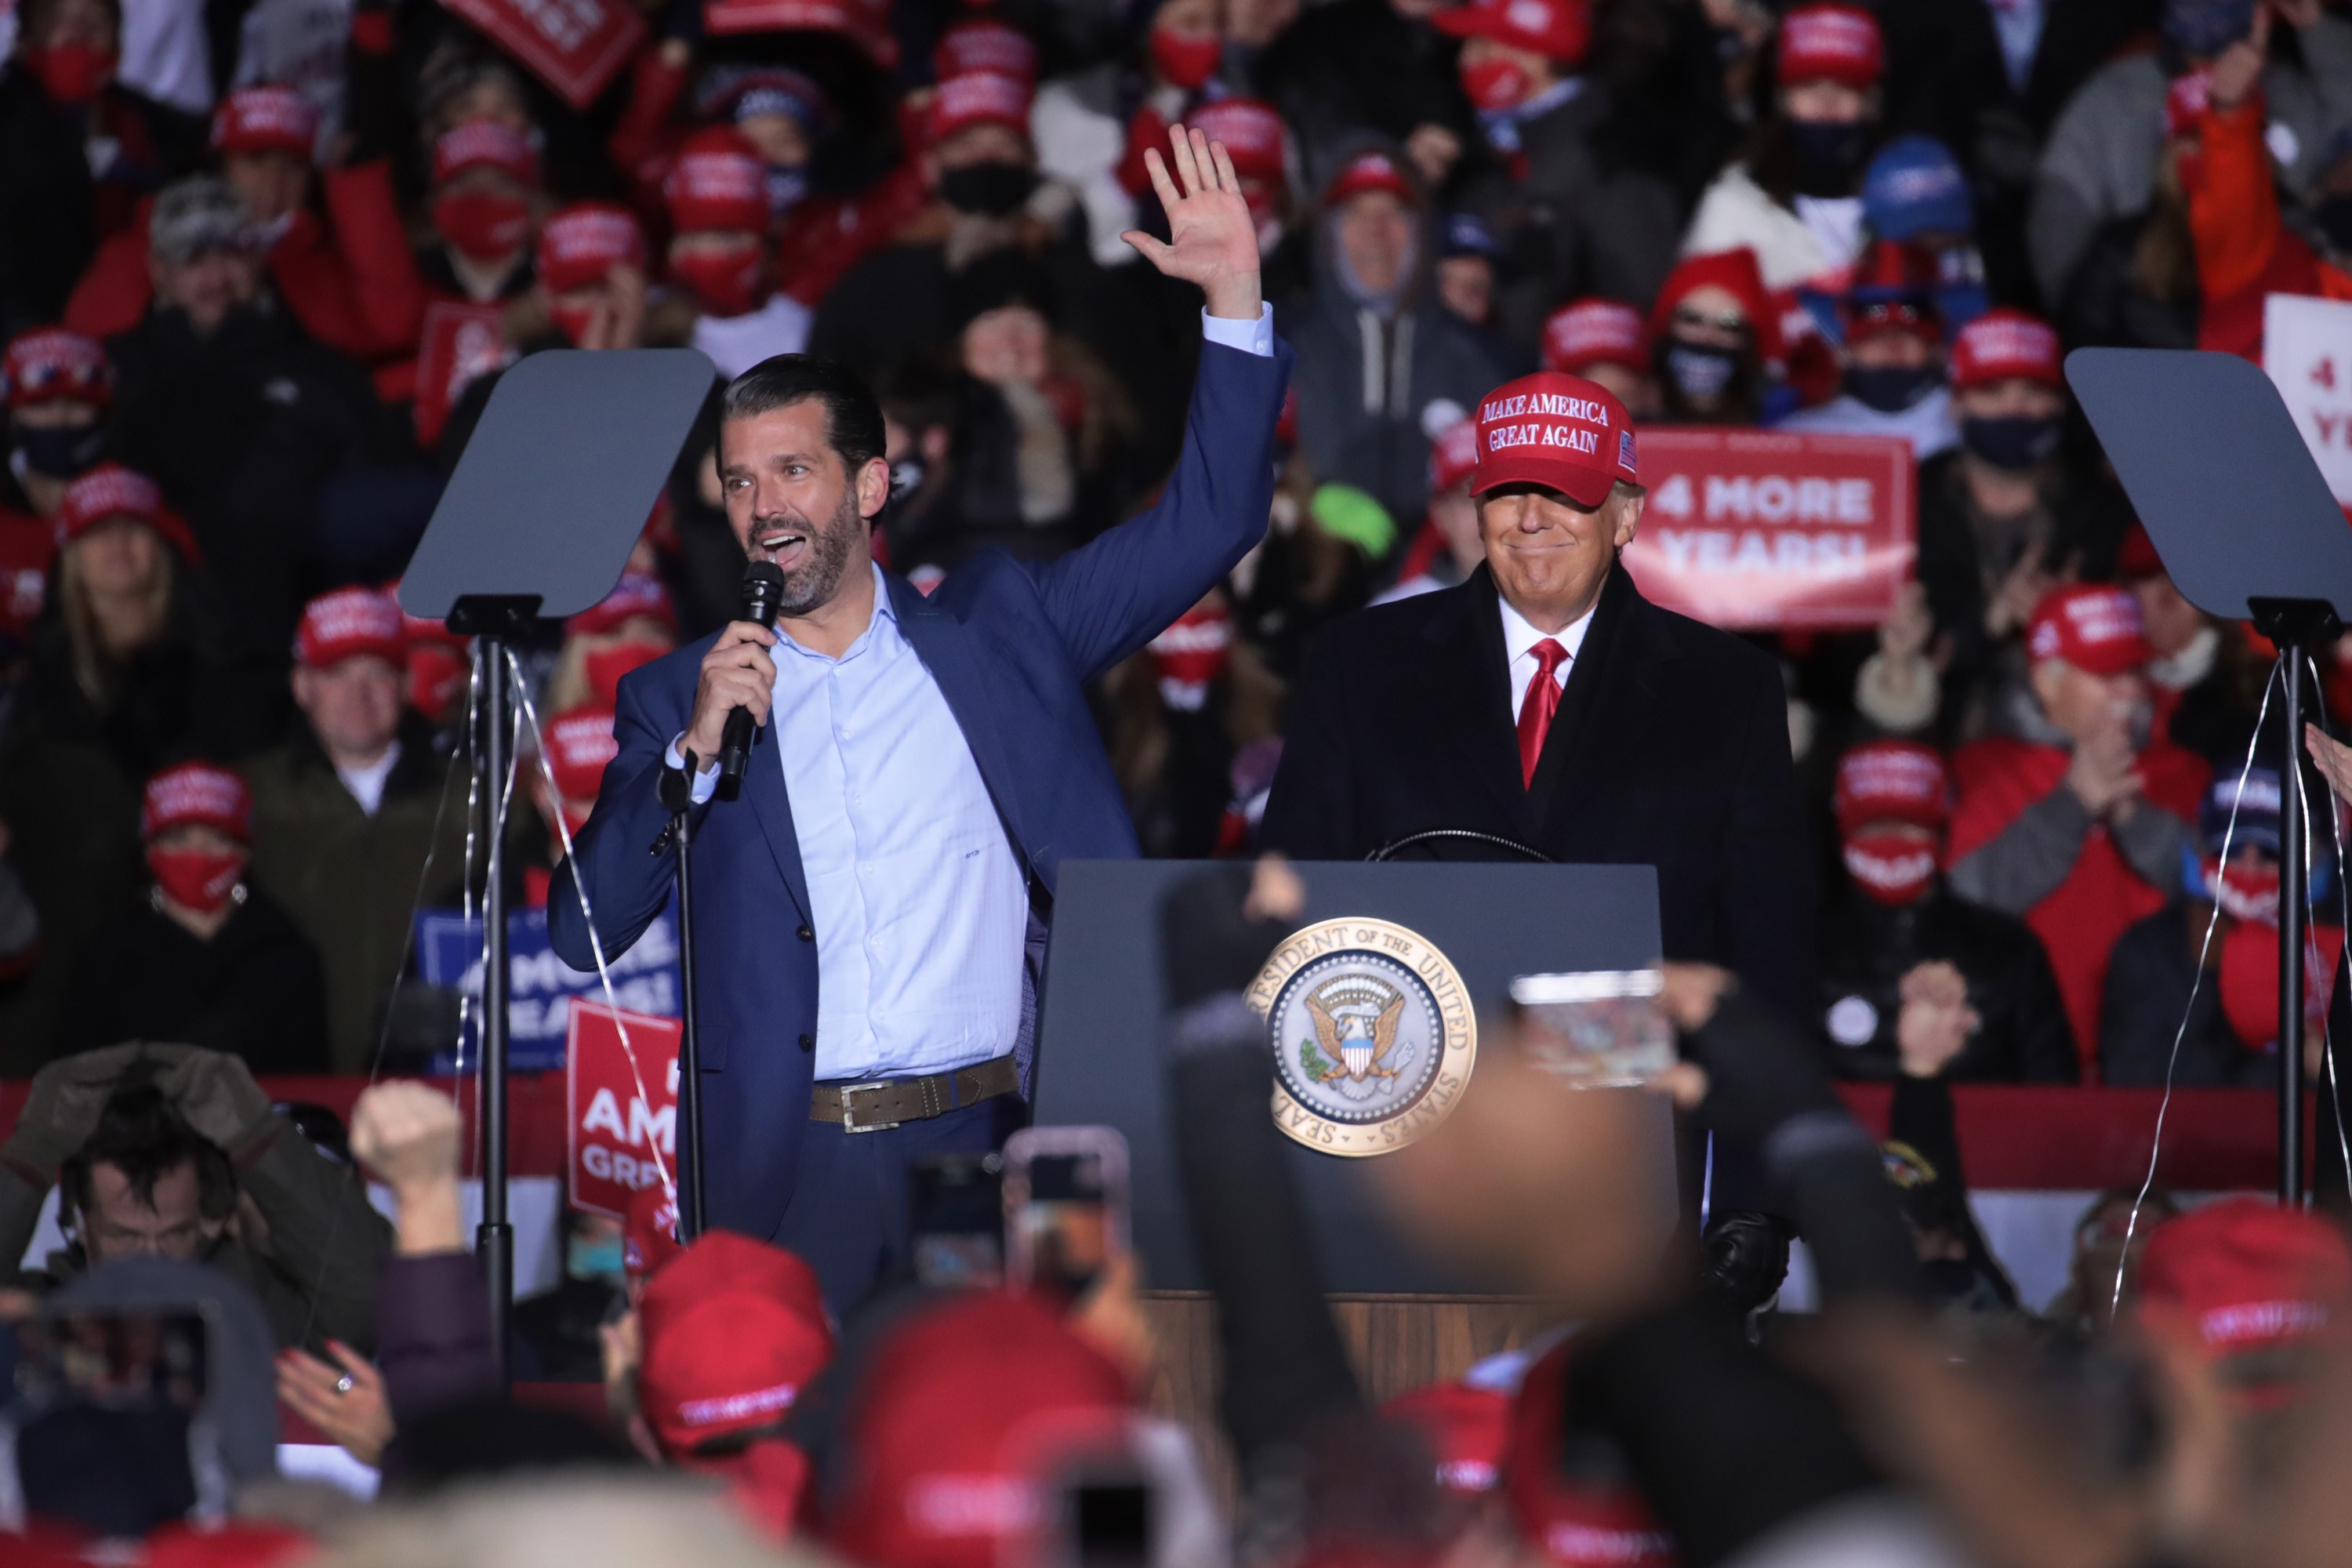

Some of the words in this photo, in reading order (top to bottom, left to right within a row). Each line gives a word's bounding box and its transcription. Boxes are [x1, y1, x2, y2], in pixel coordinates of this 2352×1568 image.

[1482, 394, 1527, 424] MAKE
[1527, 393, 1609, 427] AMERICA
[1489, 423, 1540, 452] GREAT
[1541, 423, 1599, 455] AGAIN
[1651, 473, 1693, 520] 4
[1704, 475, 1875, 524] MORE
[1657, 528, 1867, 579] YEARS!
[1355, 927, 1378, 944] OF
[1382, 932, 1413, 956] THE
[1247, 926, 1349, 1011] RESIDENT
[1417, 952, 1469, 1051] UNITED
[582, 1087, 677, 1155] AM
[1274, 1094, 1337, 1144] SEAL
[1380, 1071, 1460, 1144] STATES
